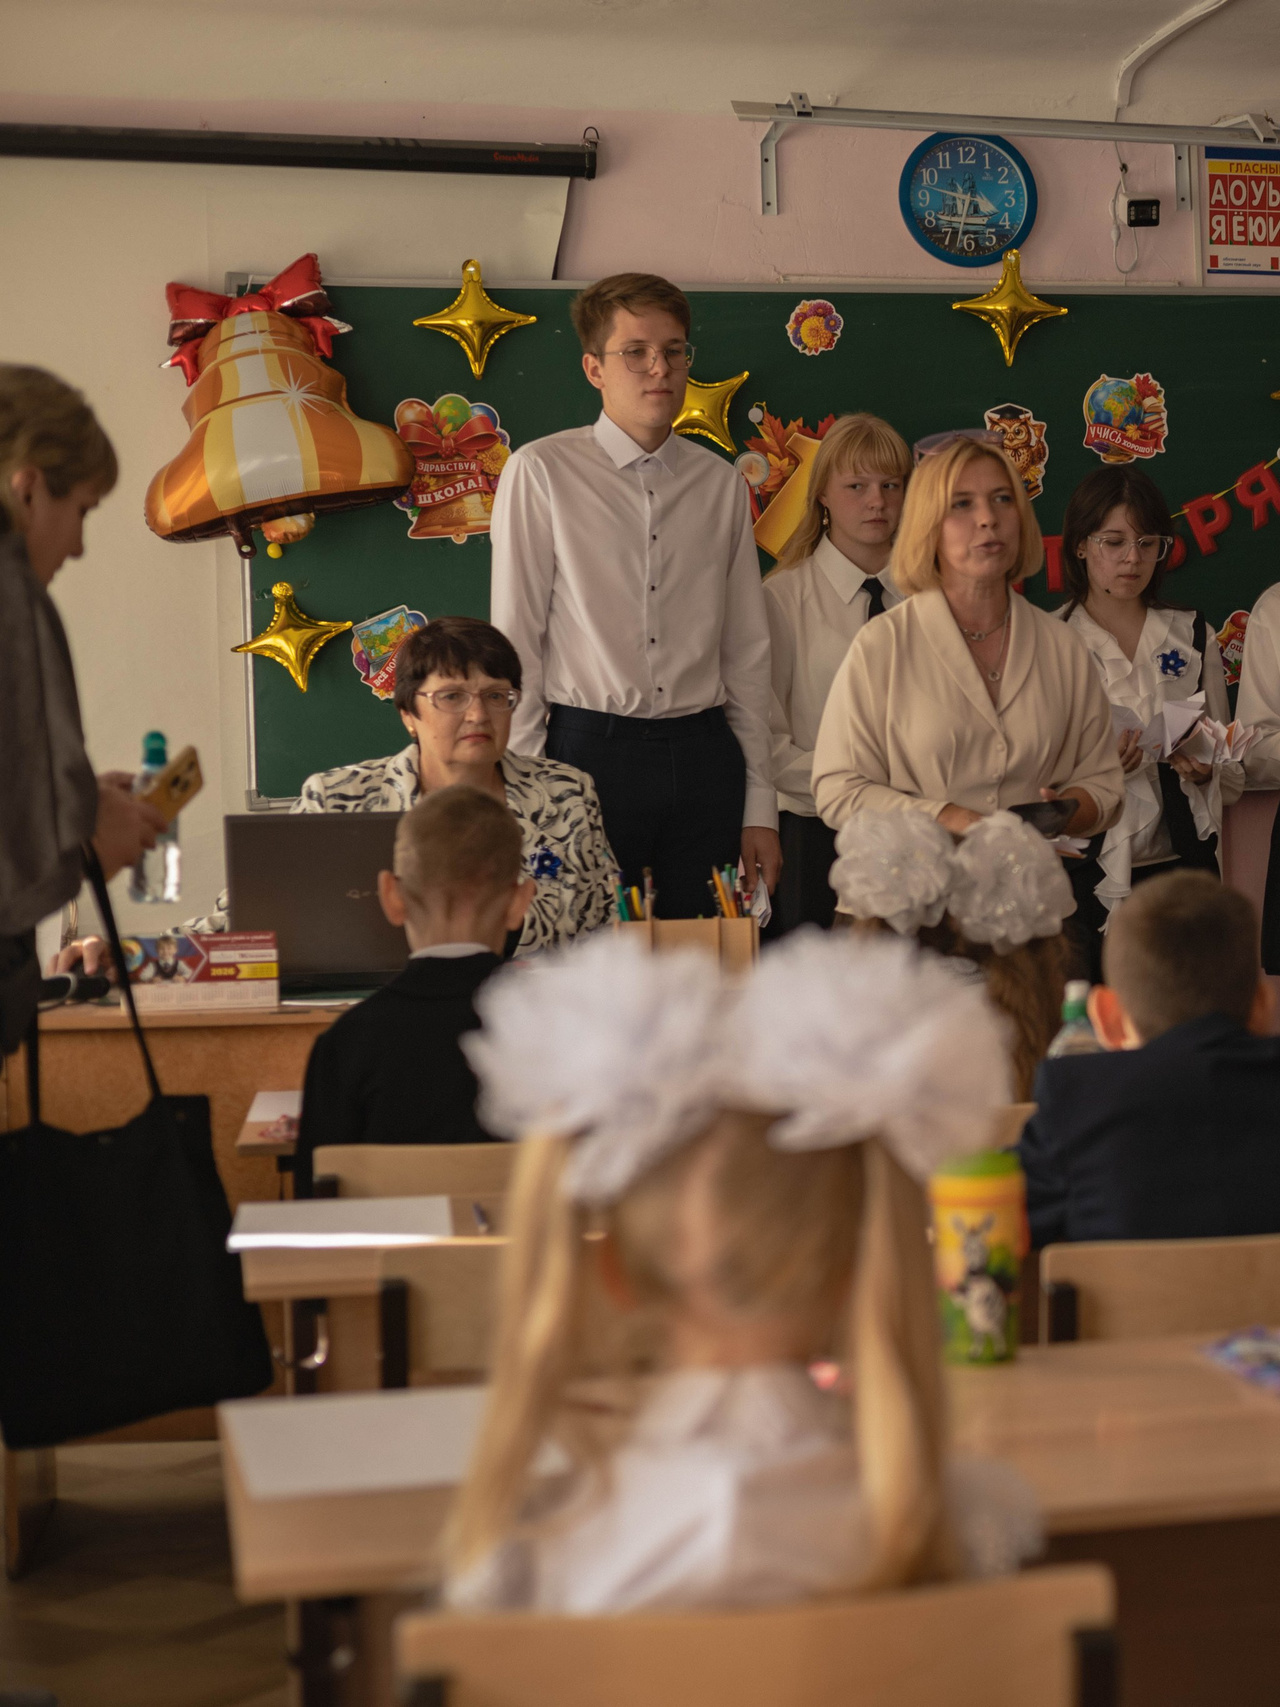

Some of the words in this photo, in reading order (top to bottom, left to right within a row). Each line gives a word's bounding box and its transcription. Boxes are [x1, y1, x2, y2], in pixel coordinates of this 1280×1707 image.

[936, 151, 952, 169] 11
[957, 146, 976, 164] 12
[982, 152, 991, 169] 1
[920, 167, 938, 186] 10
[997, 166, 1009, 184] 2
[918, 190, 930, 207] 9
[1004, 190, 1016, 208] 3
[924, 210, 936, 227] 8
[999, 212, 1010, 229] 4
[941, 228, 952, 245] 7
[963, 233, 975, 251] 6
[985, 228, 996, 247] 5
[1090, 426, 1122, 444] УЧИСЬ
[417, 476, 483, 504] ШКОЛА!
